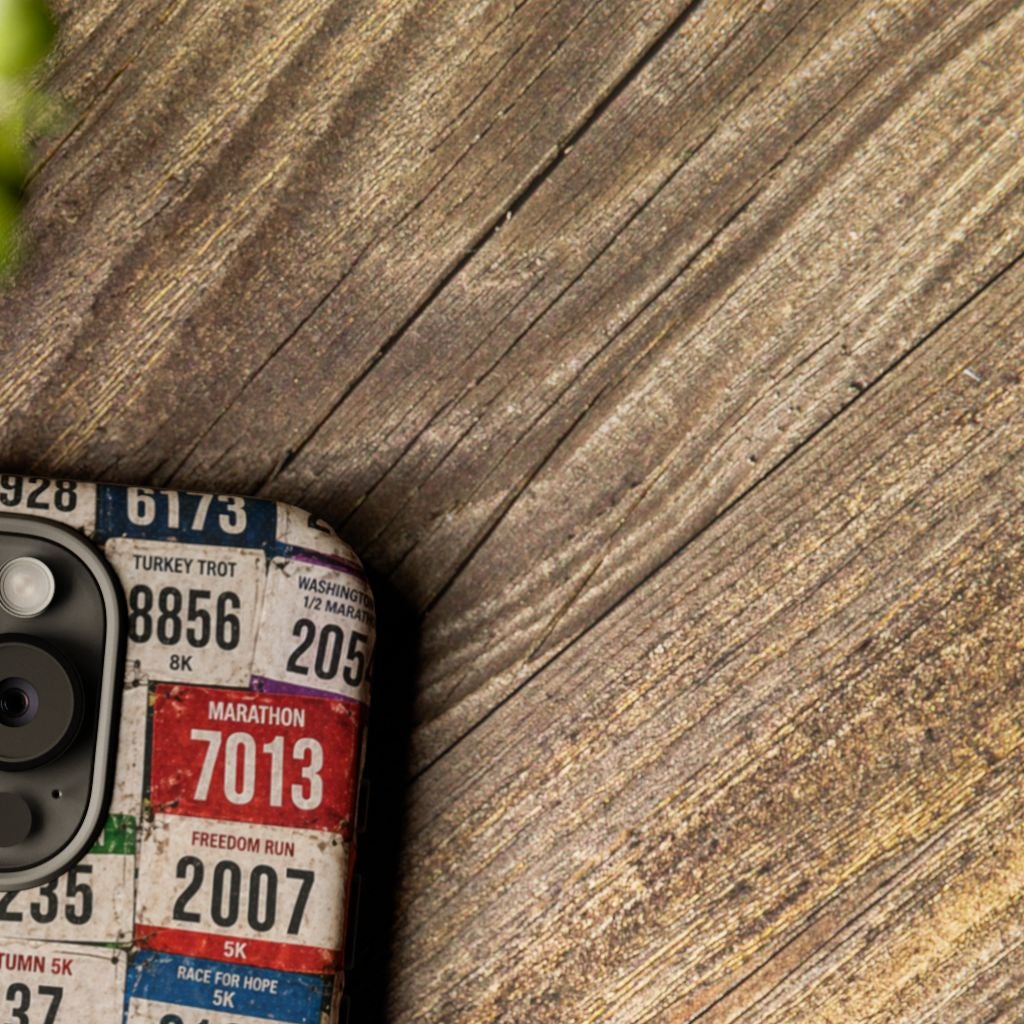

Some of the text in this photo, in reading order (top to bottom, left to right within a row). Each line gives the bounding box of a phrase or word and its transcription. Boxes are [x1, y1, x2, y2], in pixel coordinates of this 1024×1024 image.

[127, 487, 247, 534] 6173
[133, 554, 237, 577] TURKEY TROT
[303, 595, 322, 611] 1/2
[127, 584, 241, 651] 8856
[169, 655, 193, 672] 8K
[208, 701, 305, 728] MARATHON
[190, 728, 324, 811] 7013
[191, 831, 295, 857] FREEDOM RUN
[172, 855, 315, 936] 2007
[224, 941, 247, 959] 5K
[51, 958, 74, 976] 5K
[177, 965, 278, 994] RACE FOR HOPE
[212, 990, 235, 1008] 5K
